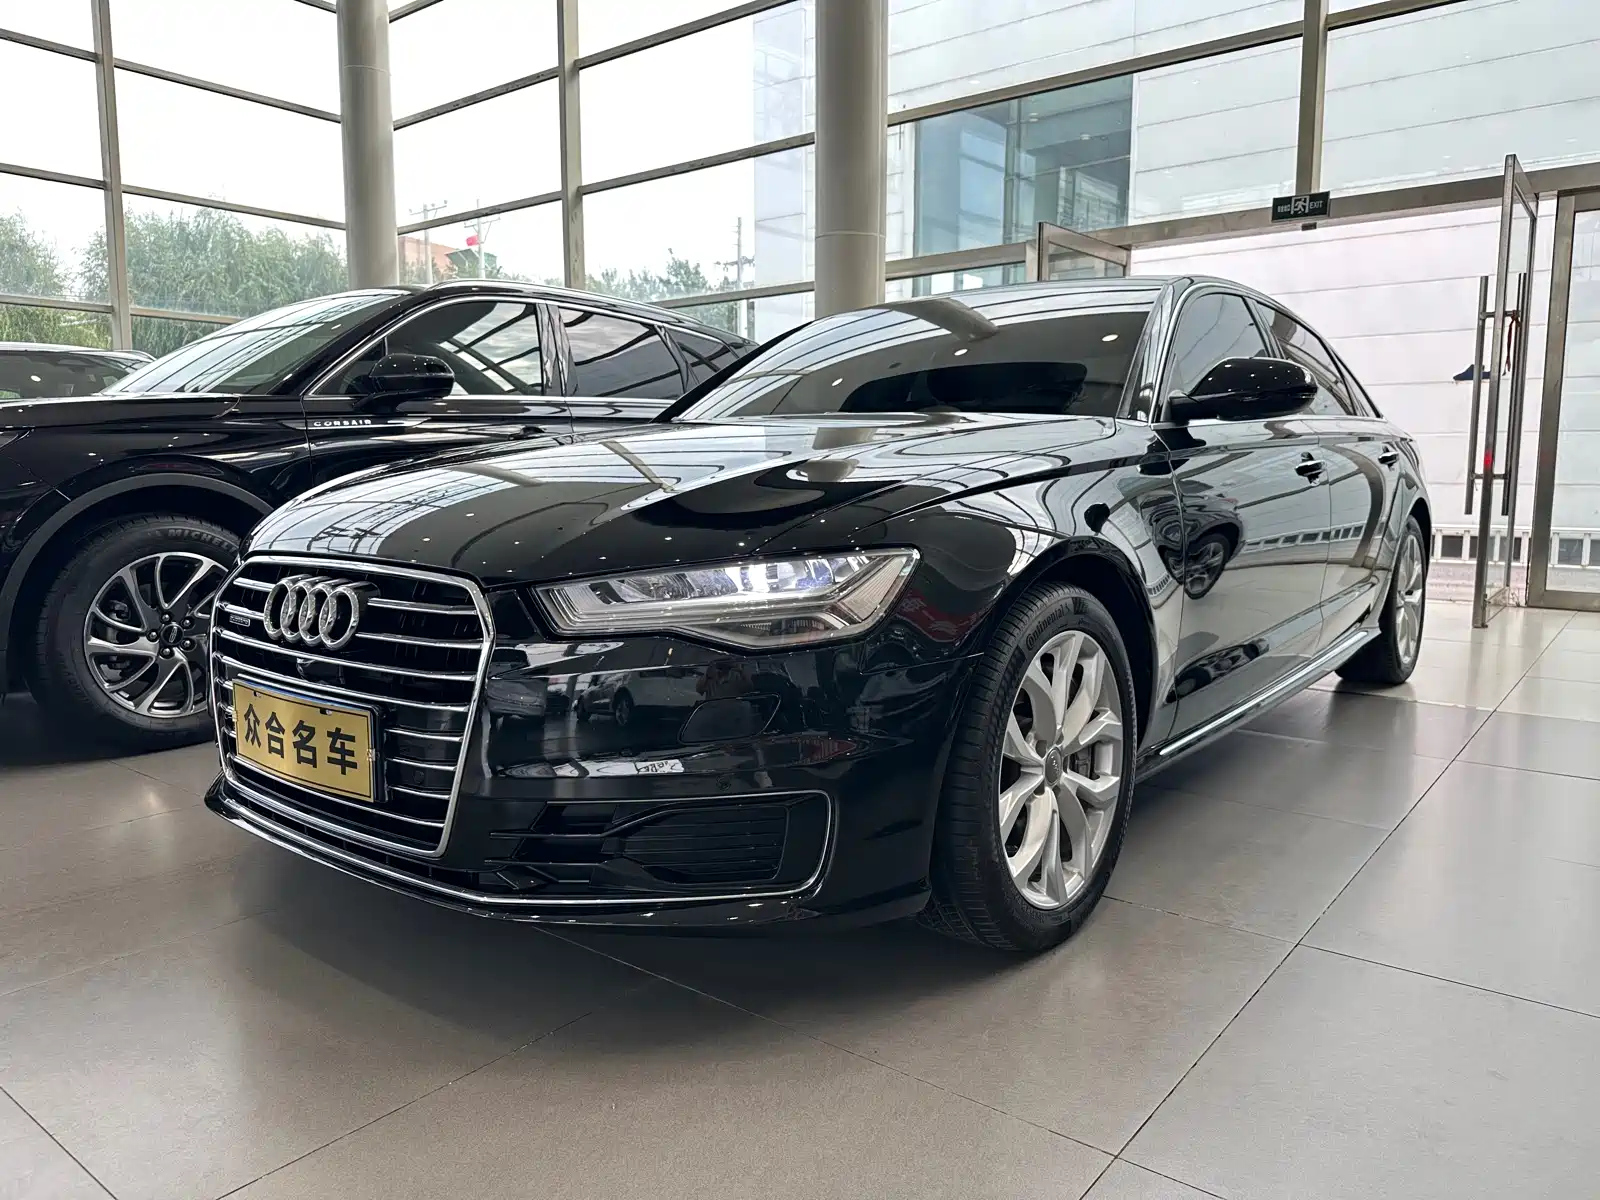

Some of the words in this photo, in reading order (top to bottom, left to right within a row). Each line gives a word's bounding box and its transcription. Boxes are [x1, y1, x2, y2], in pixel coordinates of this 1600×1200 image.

[1309, 200, 1324, 209] EXIT
[313, 419, 372, 427] CORSAIR
[167, 529, 238, 553] MICHELI
[1026, 604, 1065, 651] Continental
[243, 703, 358, 776] 众合名车
